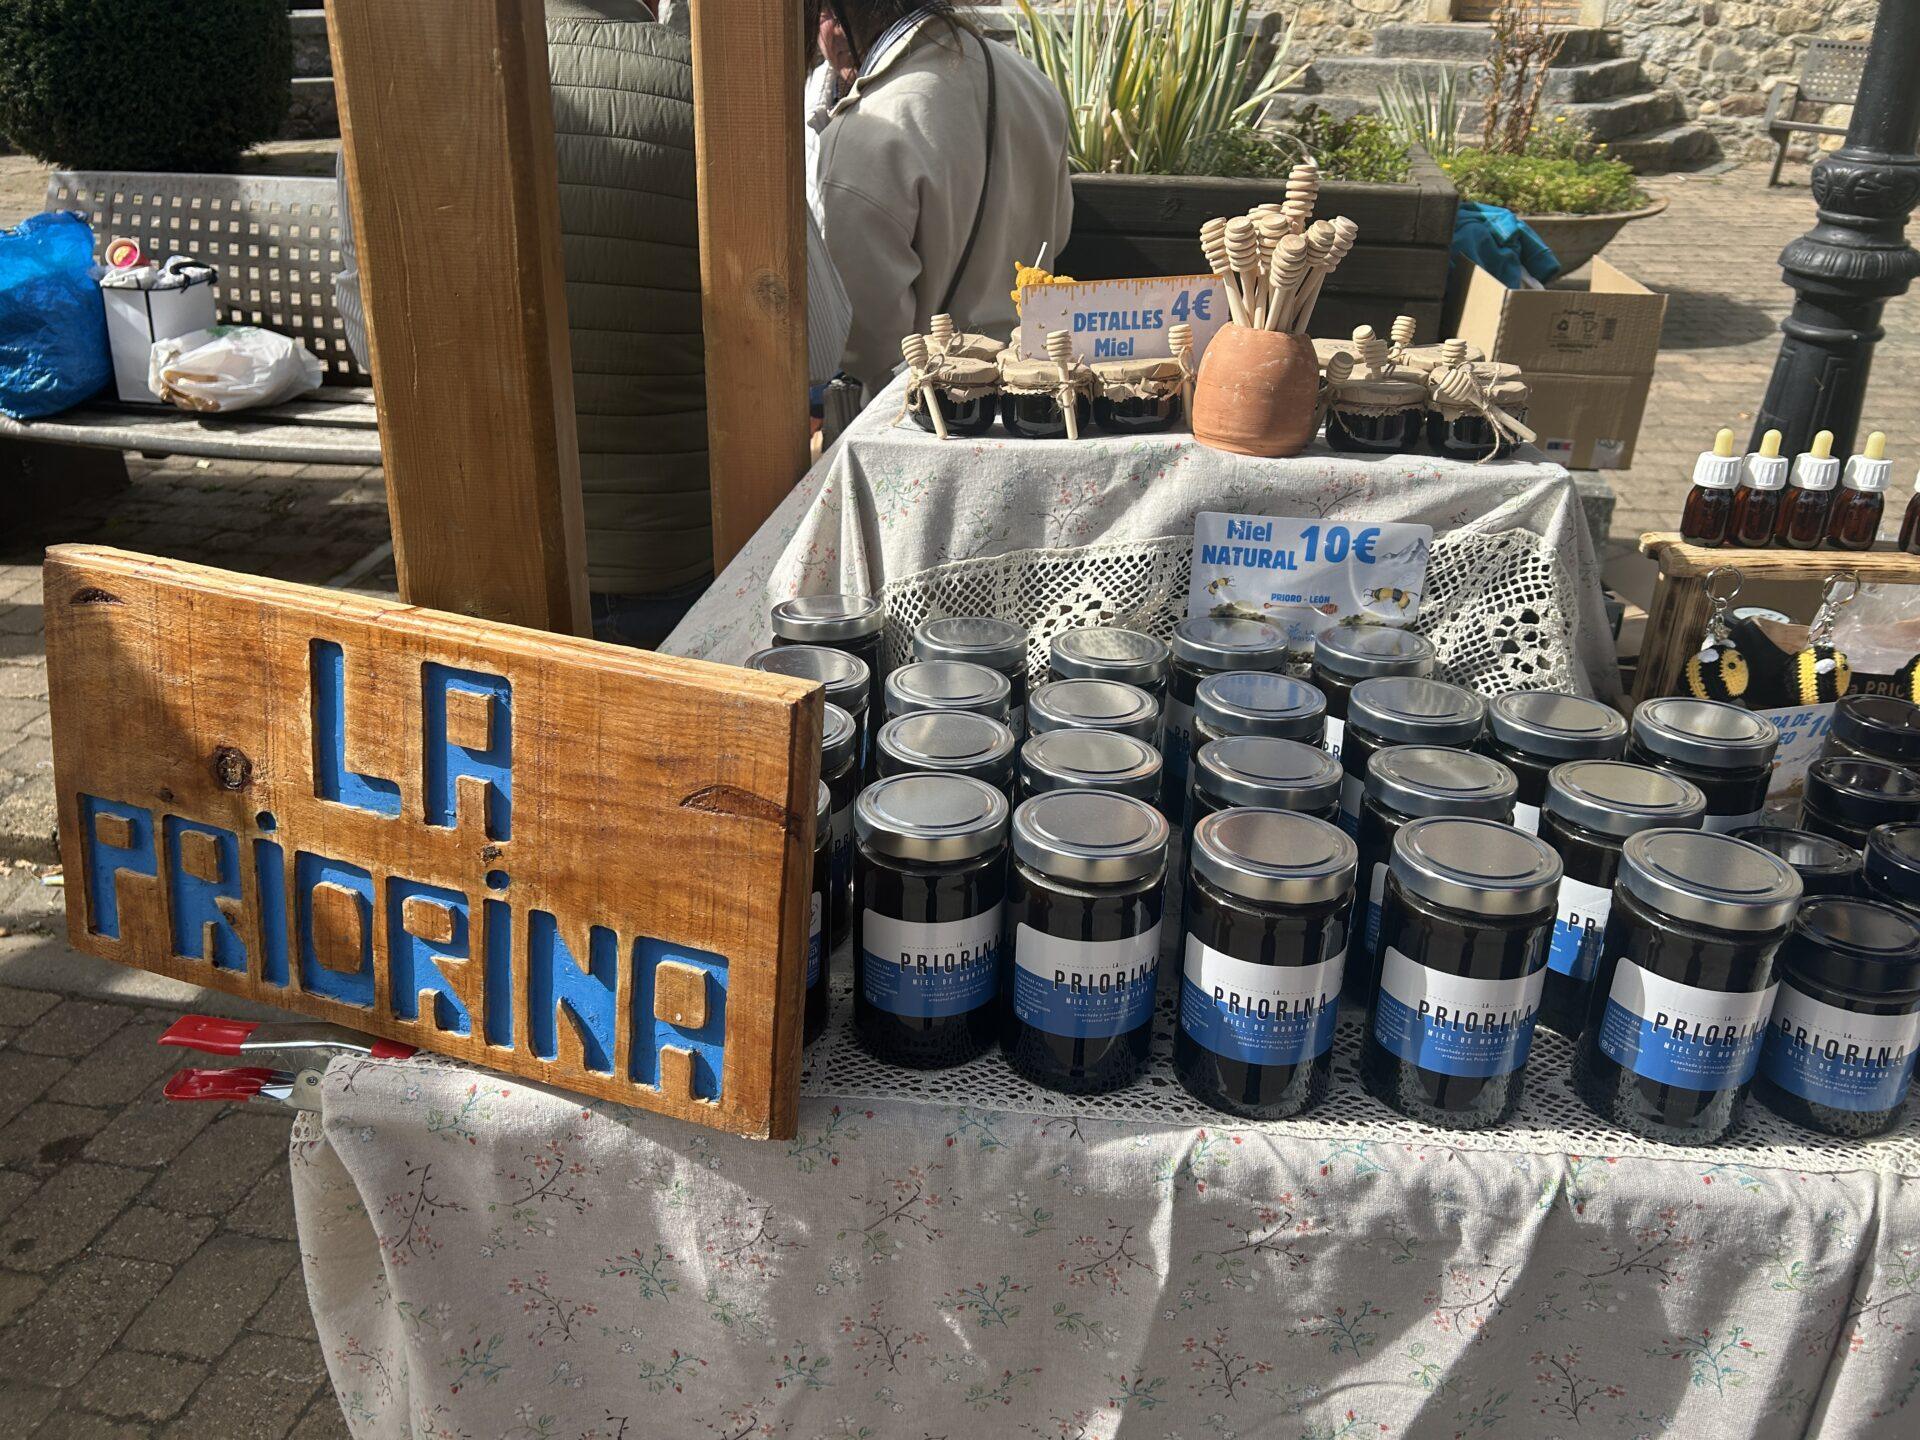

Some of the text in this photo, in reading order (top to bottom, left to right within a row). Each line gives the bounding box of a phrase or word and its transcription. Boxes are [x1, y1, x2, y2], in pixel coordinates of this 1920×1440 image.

[1073, 289, 1213, 333] DETALLES 4€
[1095, 337, 1134, 357] Miel
[1201, 525, 1381, 571] NATURAL 10€
[1227, 519, 1273, 542] Miel
[1271, 593, 1302, 603] PRIORO
[310, 637, 513, 844] LA
[77, 791, 730, 1105] PRIORINA
[1053, 955, 1155, 996] PRIORINA
[1212, 985, 1326, 1022] PRIORINA
[1416, 999, 1531, 1035] PRIORINA
[1427, 1029, 1452, 1042] MIEL
[1651, 1012, 1767, 1048] PRIORINA
[1663, 1041, 1690, 1055] MIEL
[1780, 1017, 1905, 1069] PRIORINA
